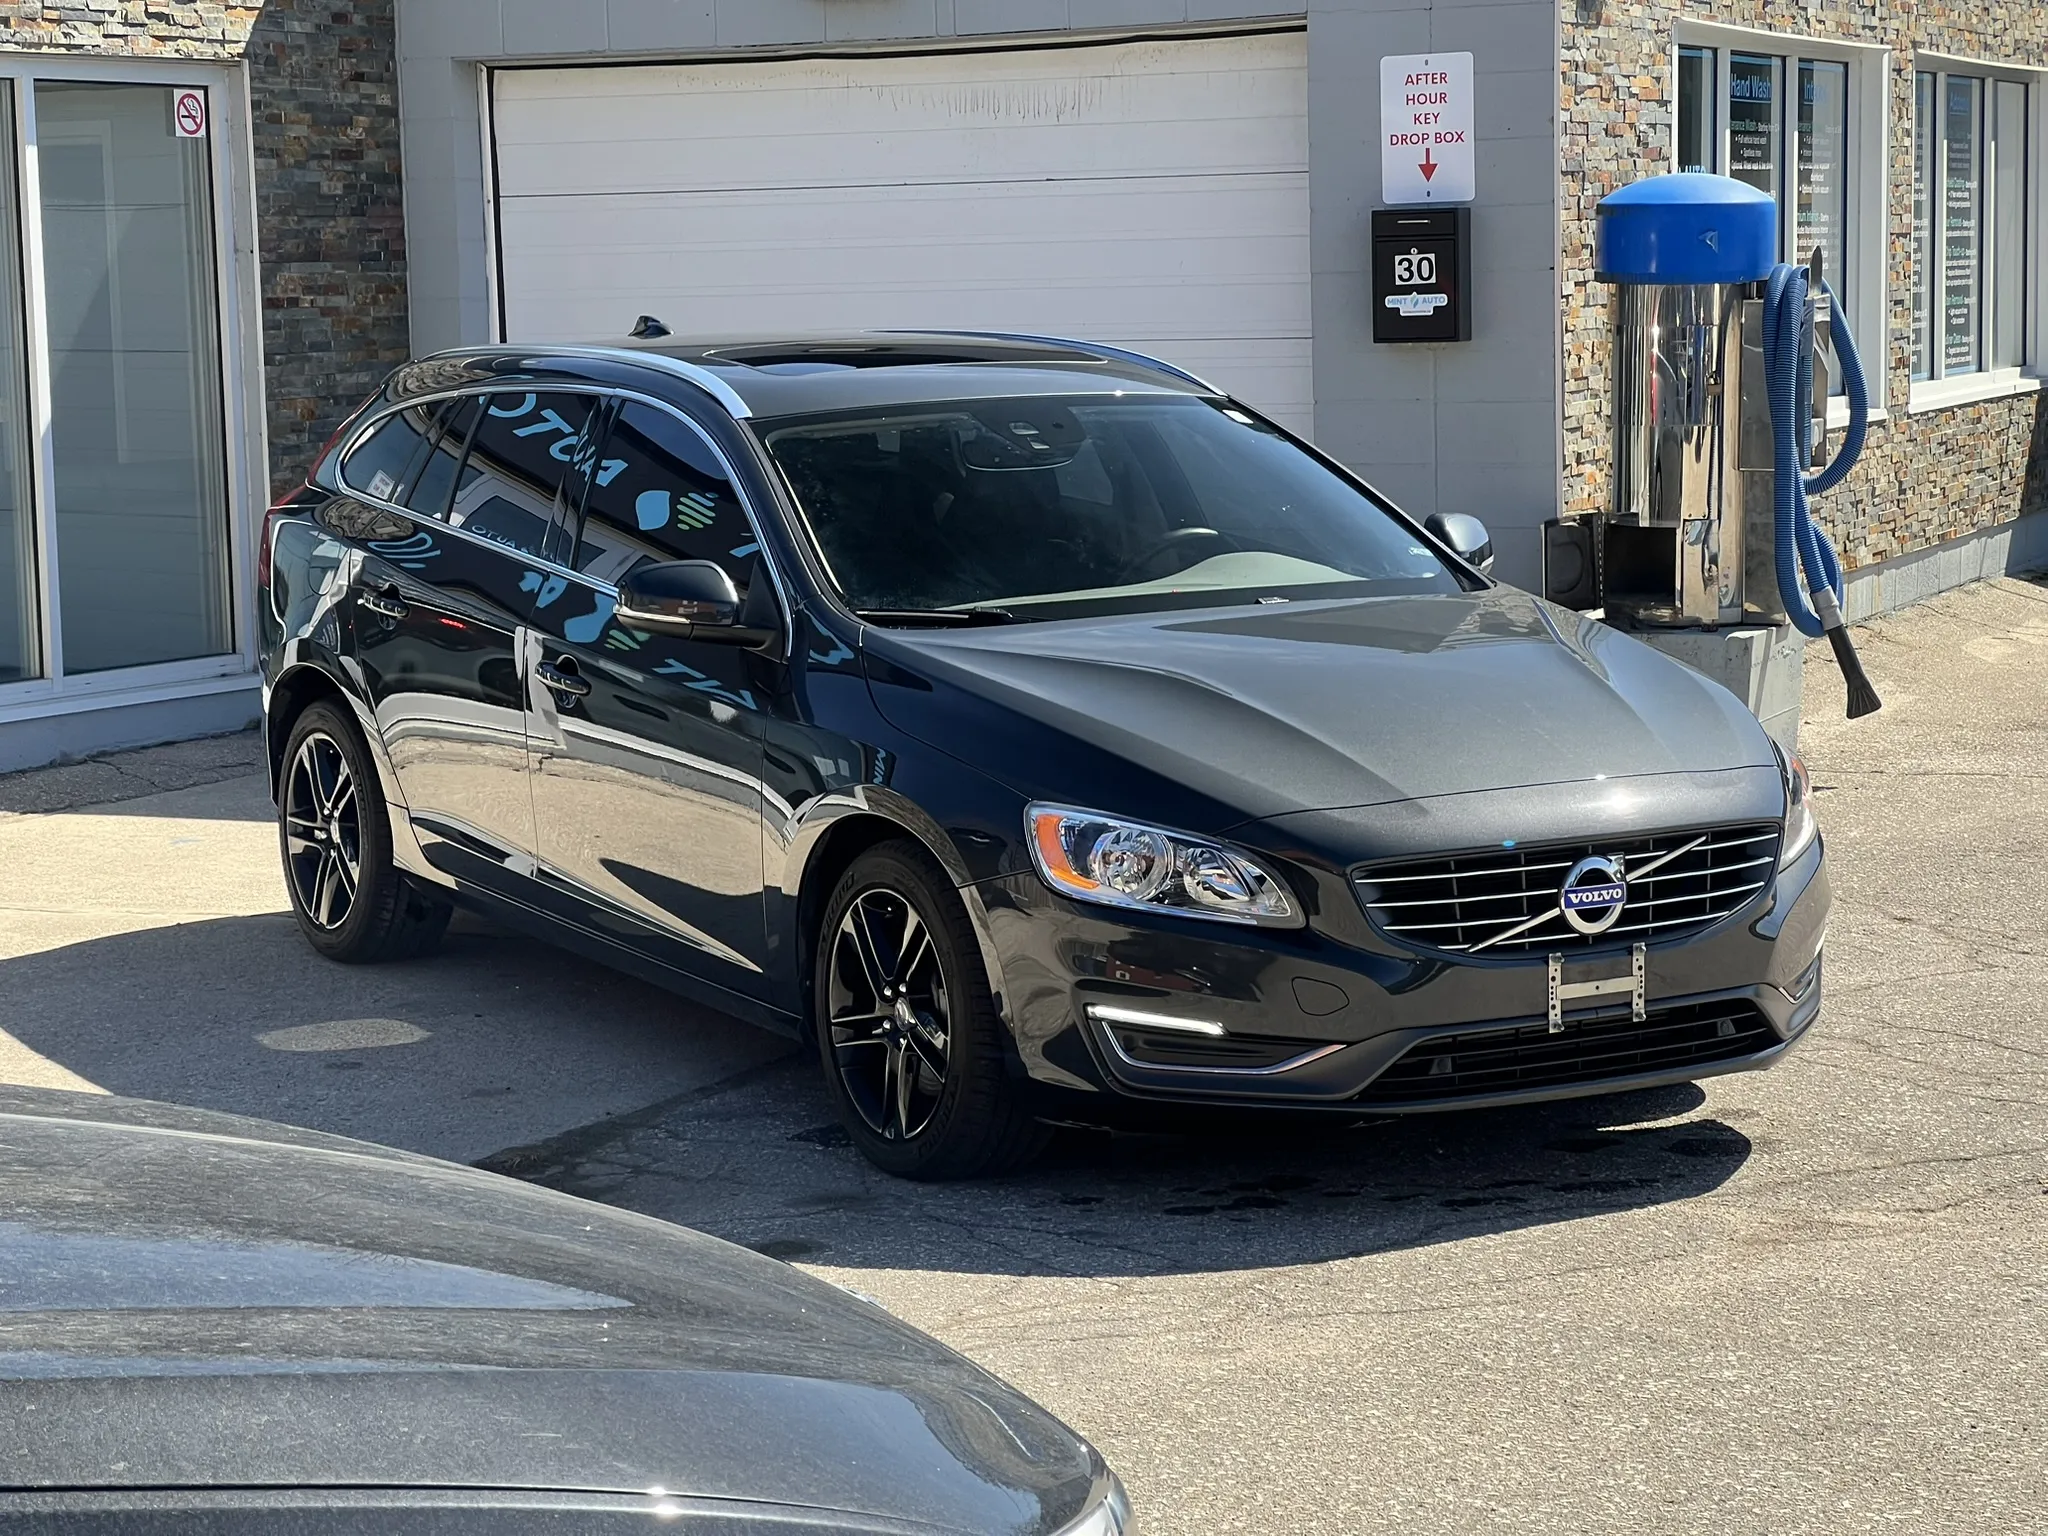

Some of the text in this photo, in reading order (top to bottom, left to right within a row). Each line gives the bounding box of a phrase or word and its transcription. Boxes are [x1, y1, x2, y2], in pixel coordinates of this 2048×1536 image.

[1404, 72, 1448, 86] AFTER
[1731, 73, 1771, 98] Hand Wash
[1405, 92, 1448, 106] HOUR
[1413, 112, 1441, 125] KEY
[1390, 130, 1465, 146] DROP BOX
[1397, 256, 1435, 283] 30
[1387, 296, 1446, 306] MINT AUTO
[1567, 888, 1622, 904] VOLVO
